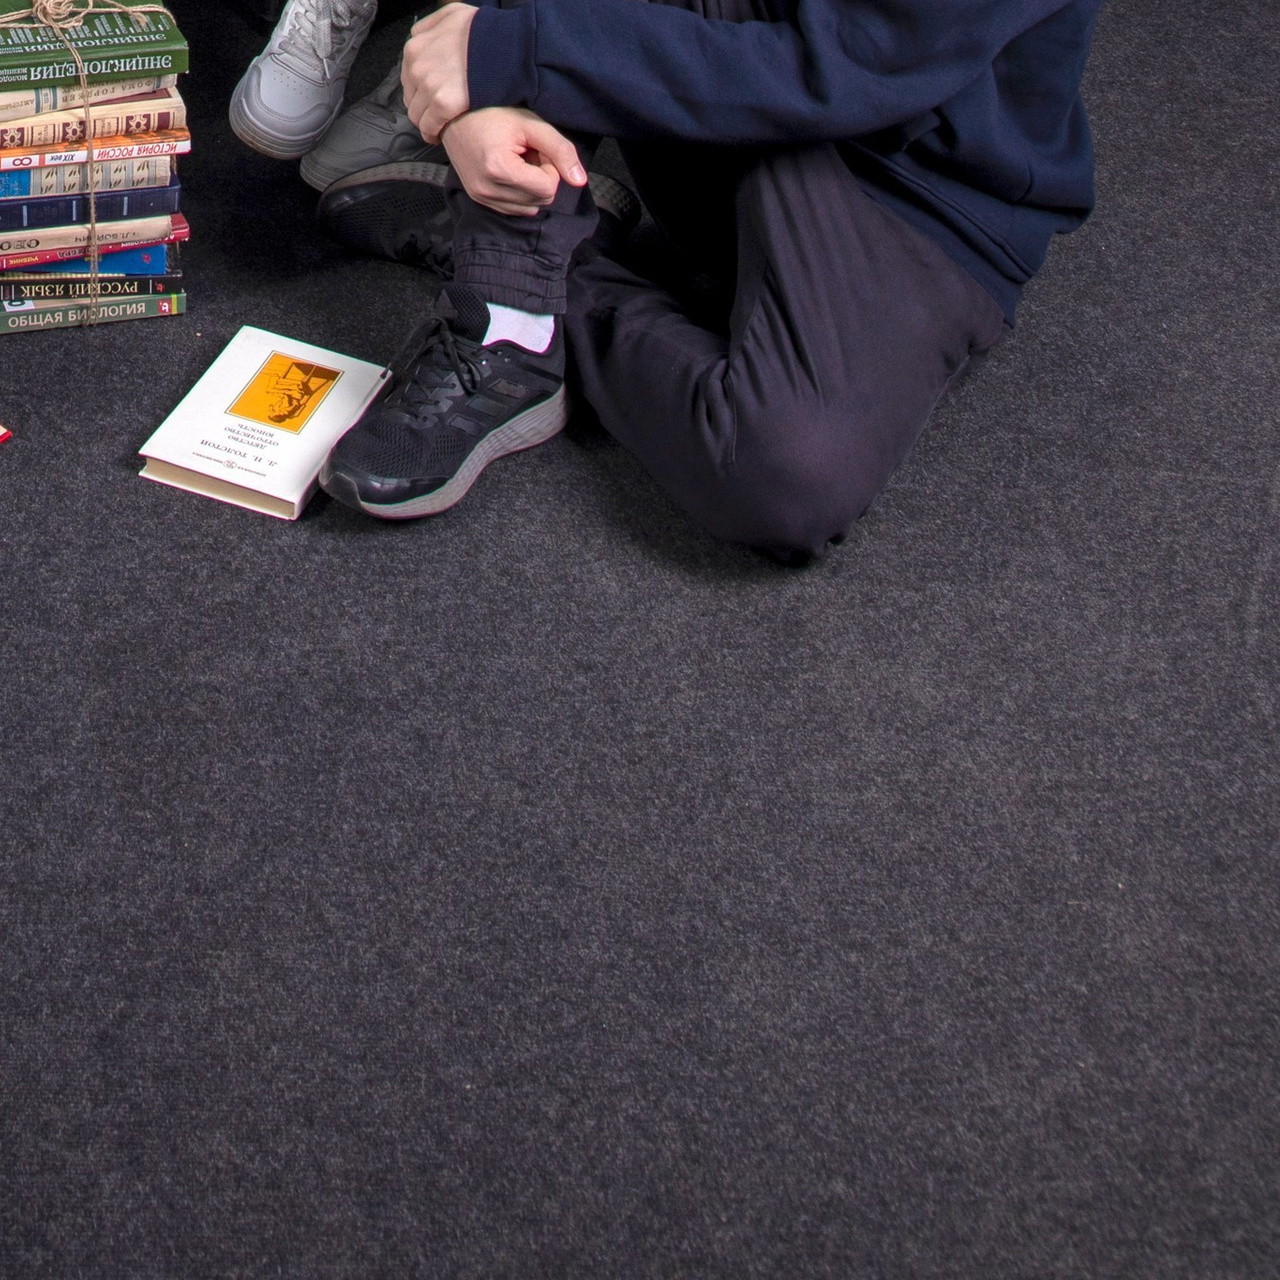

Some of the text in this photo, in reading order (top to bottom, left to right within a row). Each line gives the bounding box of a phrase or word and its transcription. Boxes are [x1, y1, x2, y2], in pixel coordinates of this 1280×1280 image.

[97, 143, 178, 159] ИСТОРИЯ РОССИИ
[12, 156, 33, 167] 8
[58, 246, 100, 259] ЛГЕБРА
[20, 284, 64, 297] ЯЗЫК
[69, 281, 138, 298] РУССКИЙ
[8, 302, 146, 328] ОБЩАЯ БИОЛОГИЯ
[224, 426, 279, 447] ОТРОЧЕСТВО
[238, 423, 274, 438] ЮНОСТЬ
[227, 434, 267, 450] ДЕТСТВО
